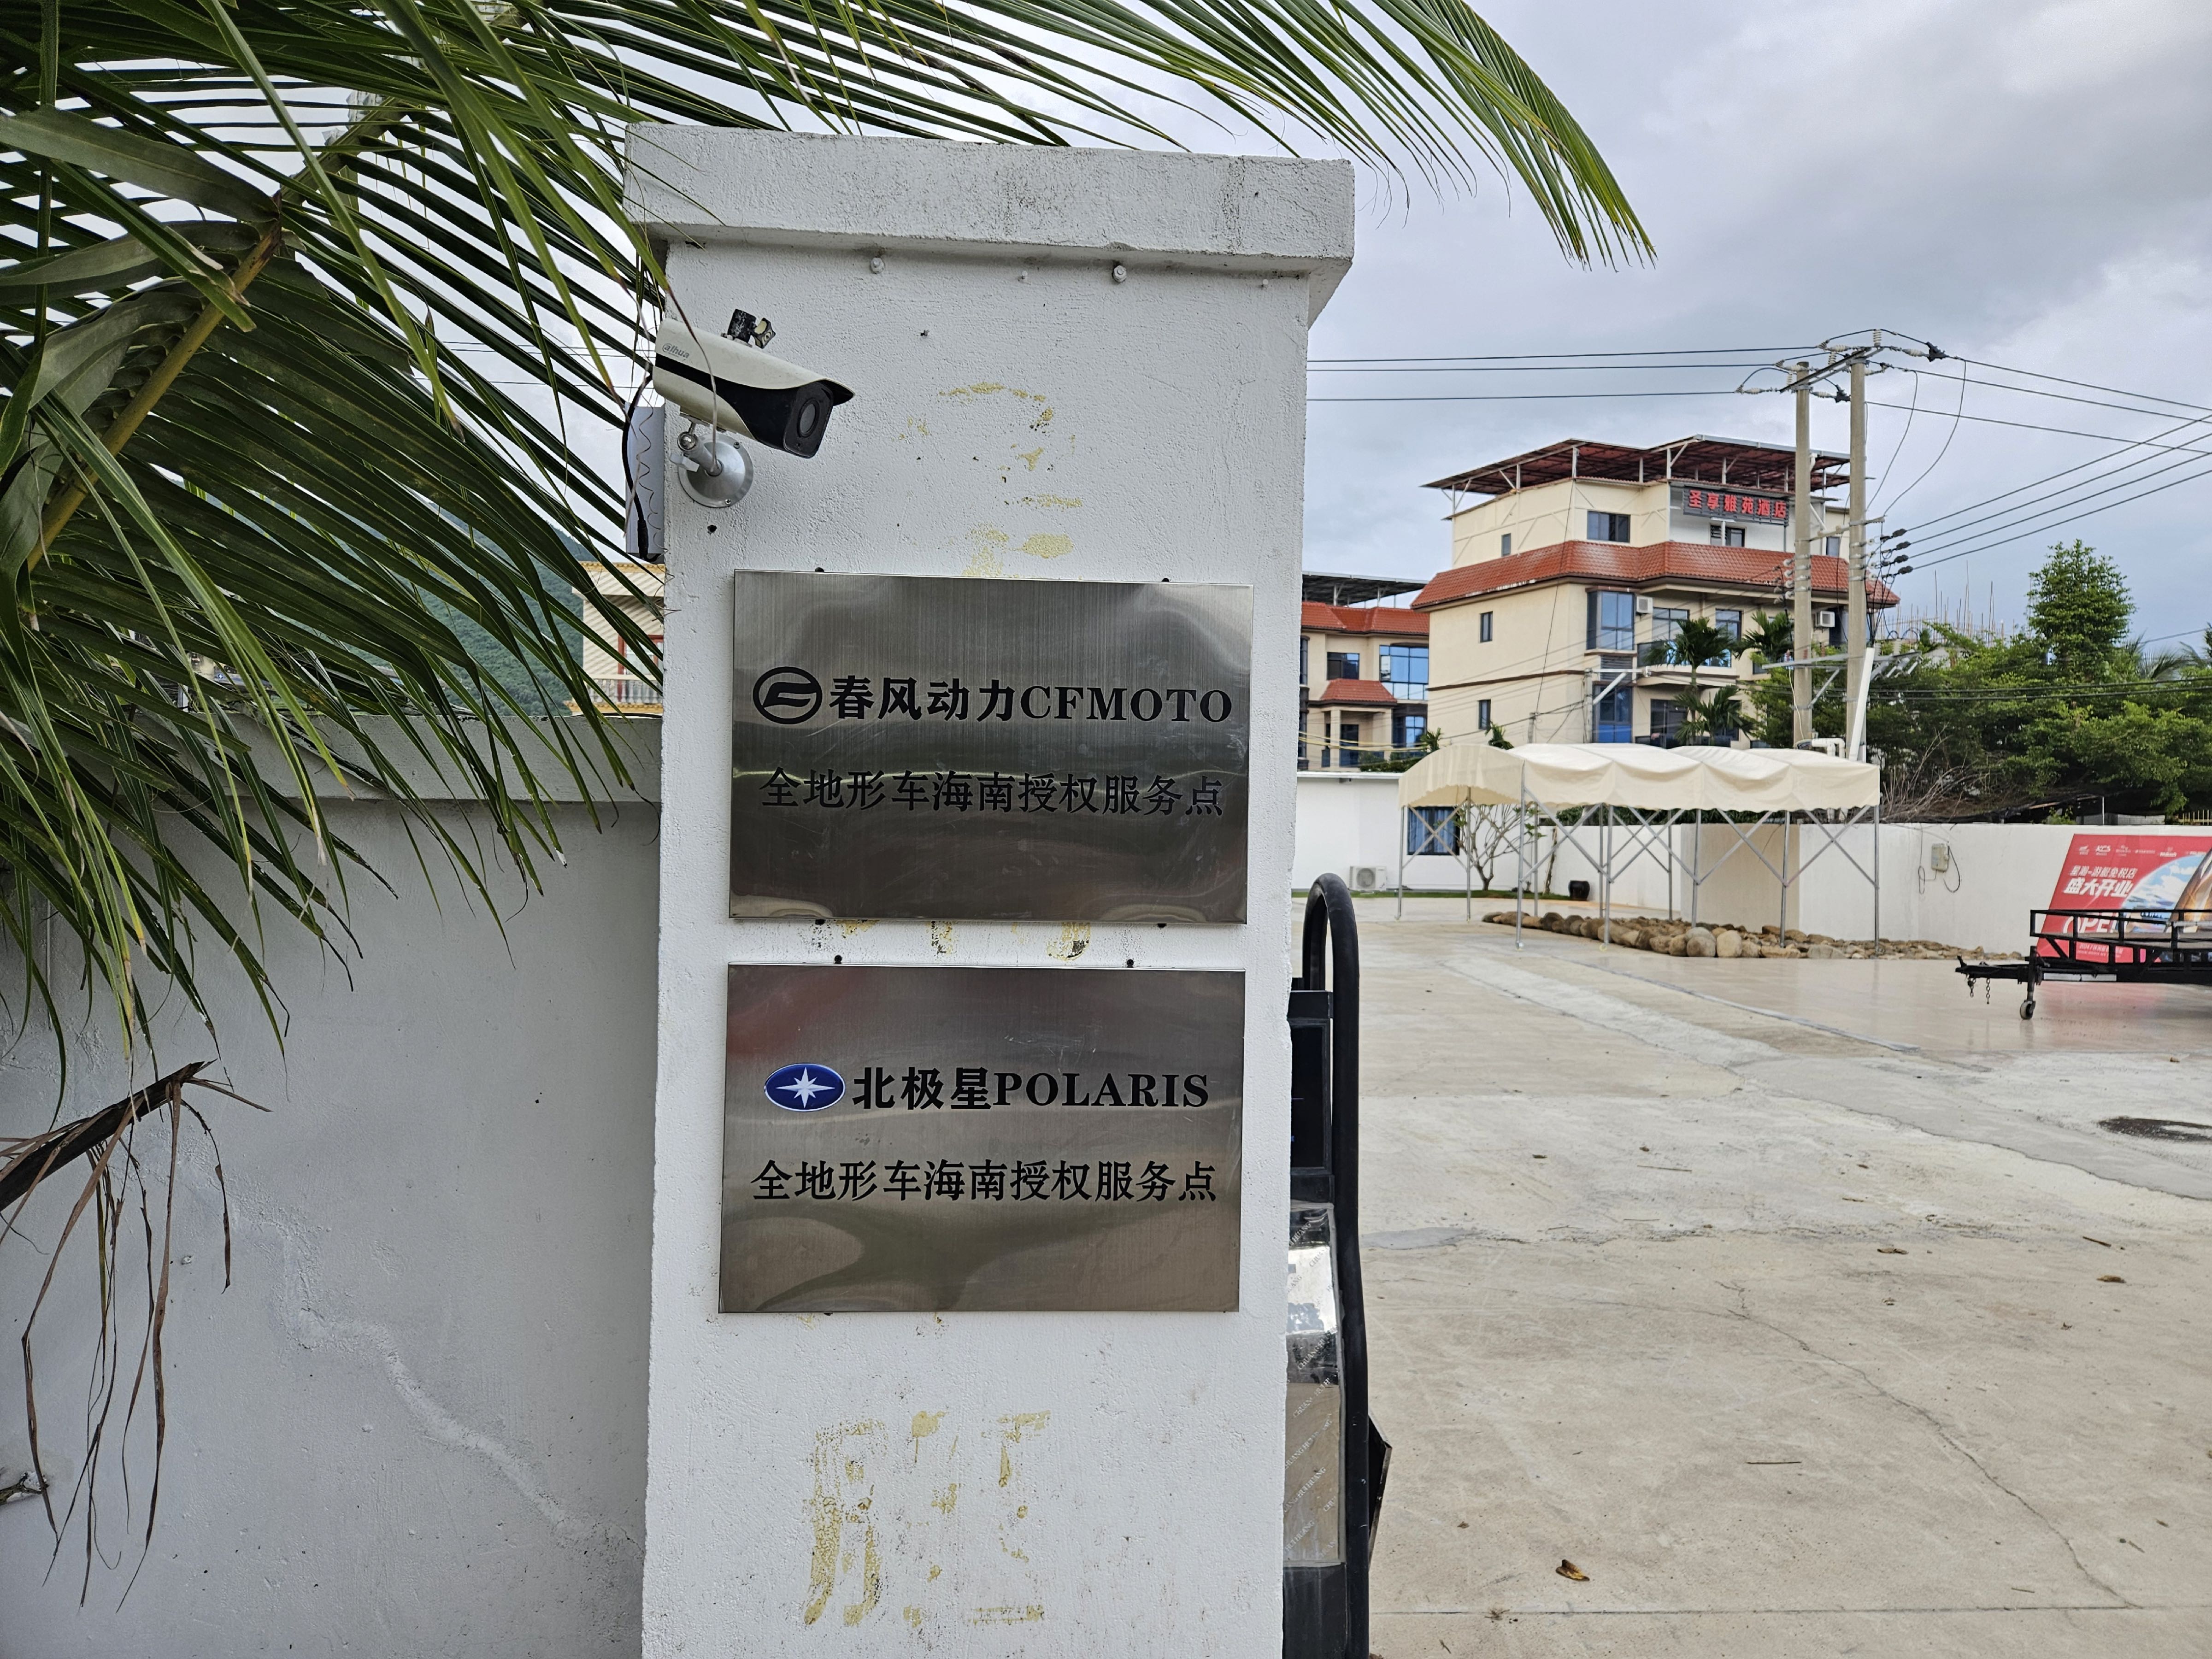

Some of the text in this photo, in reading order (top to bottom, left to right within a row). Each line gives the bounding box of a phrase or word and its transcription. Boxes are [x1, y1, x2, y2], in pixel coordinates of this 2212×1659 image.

[1689, 489, 1787, 518] 圣享雅苑酒店
[759, 766, 1224, 816] 全地形车海南授权服务点
[752, 1159, 1217, 1201] 全地形车海南授权服务点
